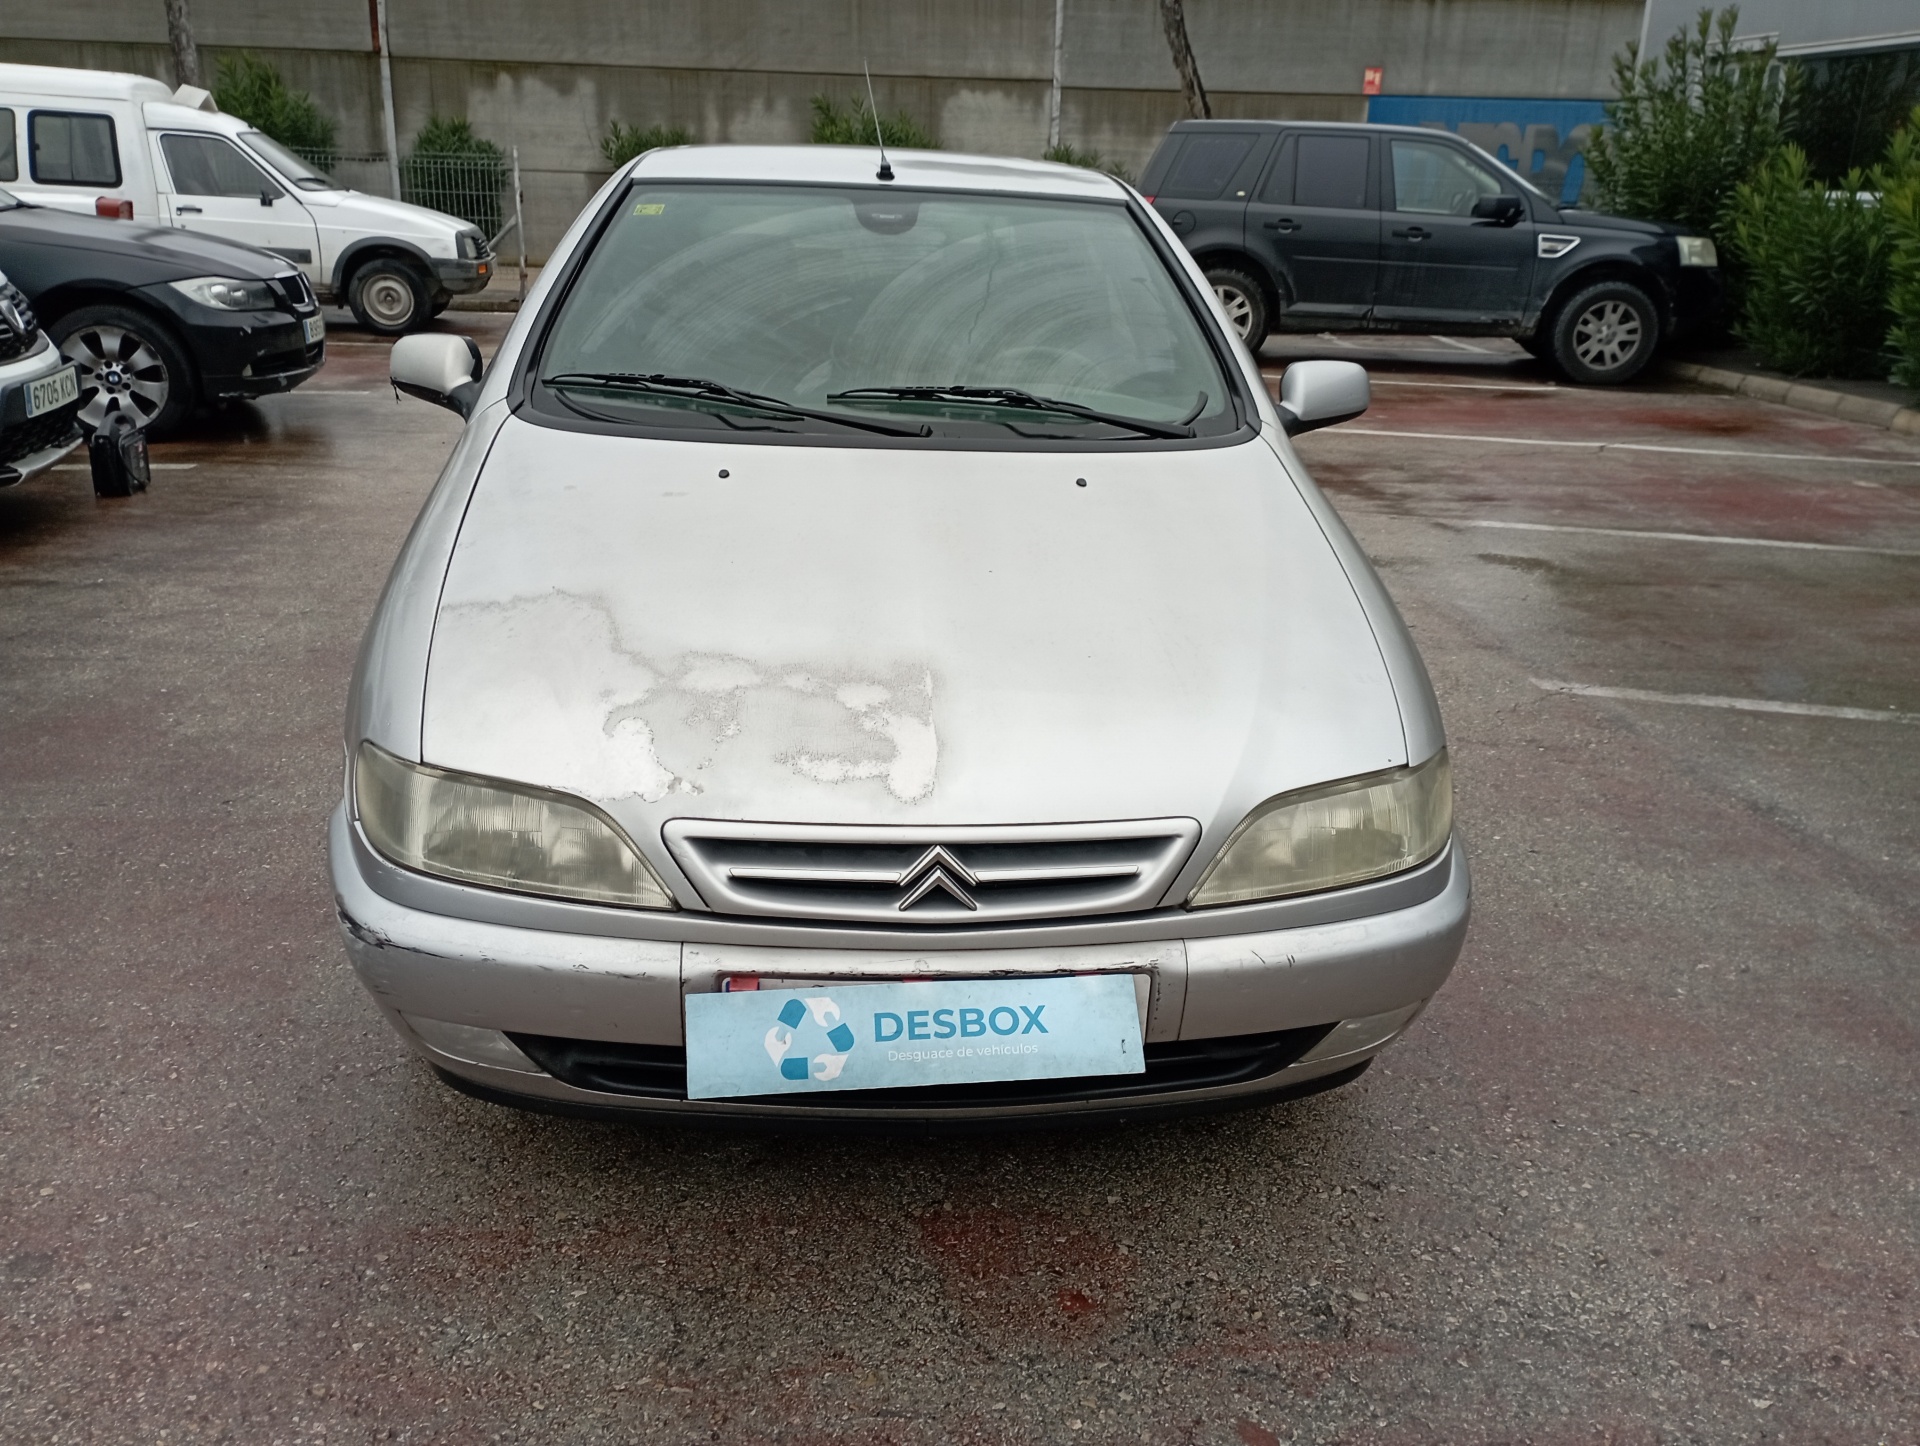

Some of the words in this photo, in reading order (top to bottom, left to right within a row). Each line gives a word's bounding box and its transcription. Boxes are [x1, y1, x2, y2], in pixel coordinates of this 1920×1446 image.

[33, 380, 59, 410] 6705
[874, 1005, 1049, 1042] DESBOX
[888, 1050, 953, 1063] Desguace
[957, 1046, 974, 1057] de
[977, 1043, 1039, 1056] vehículos
